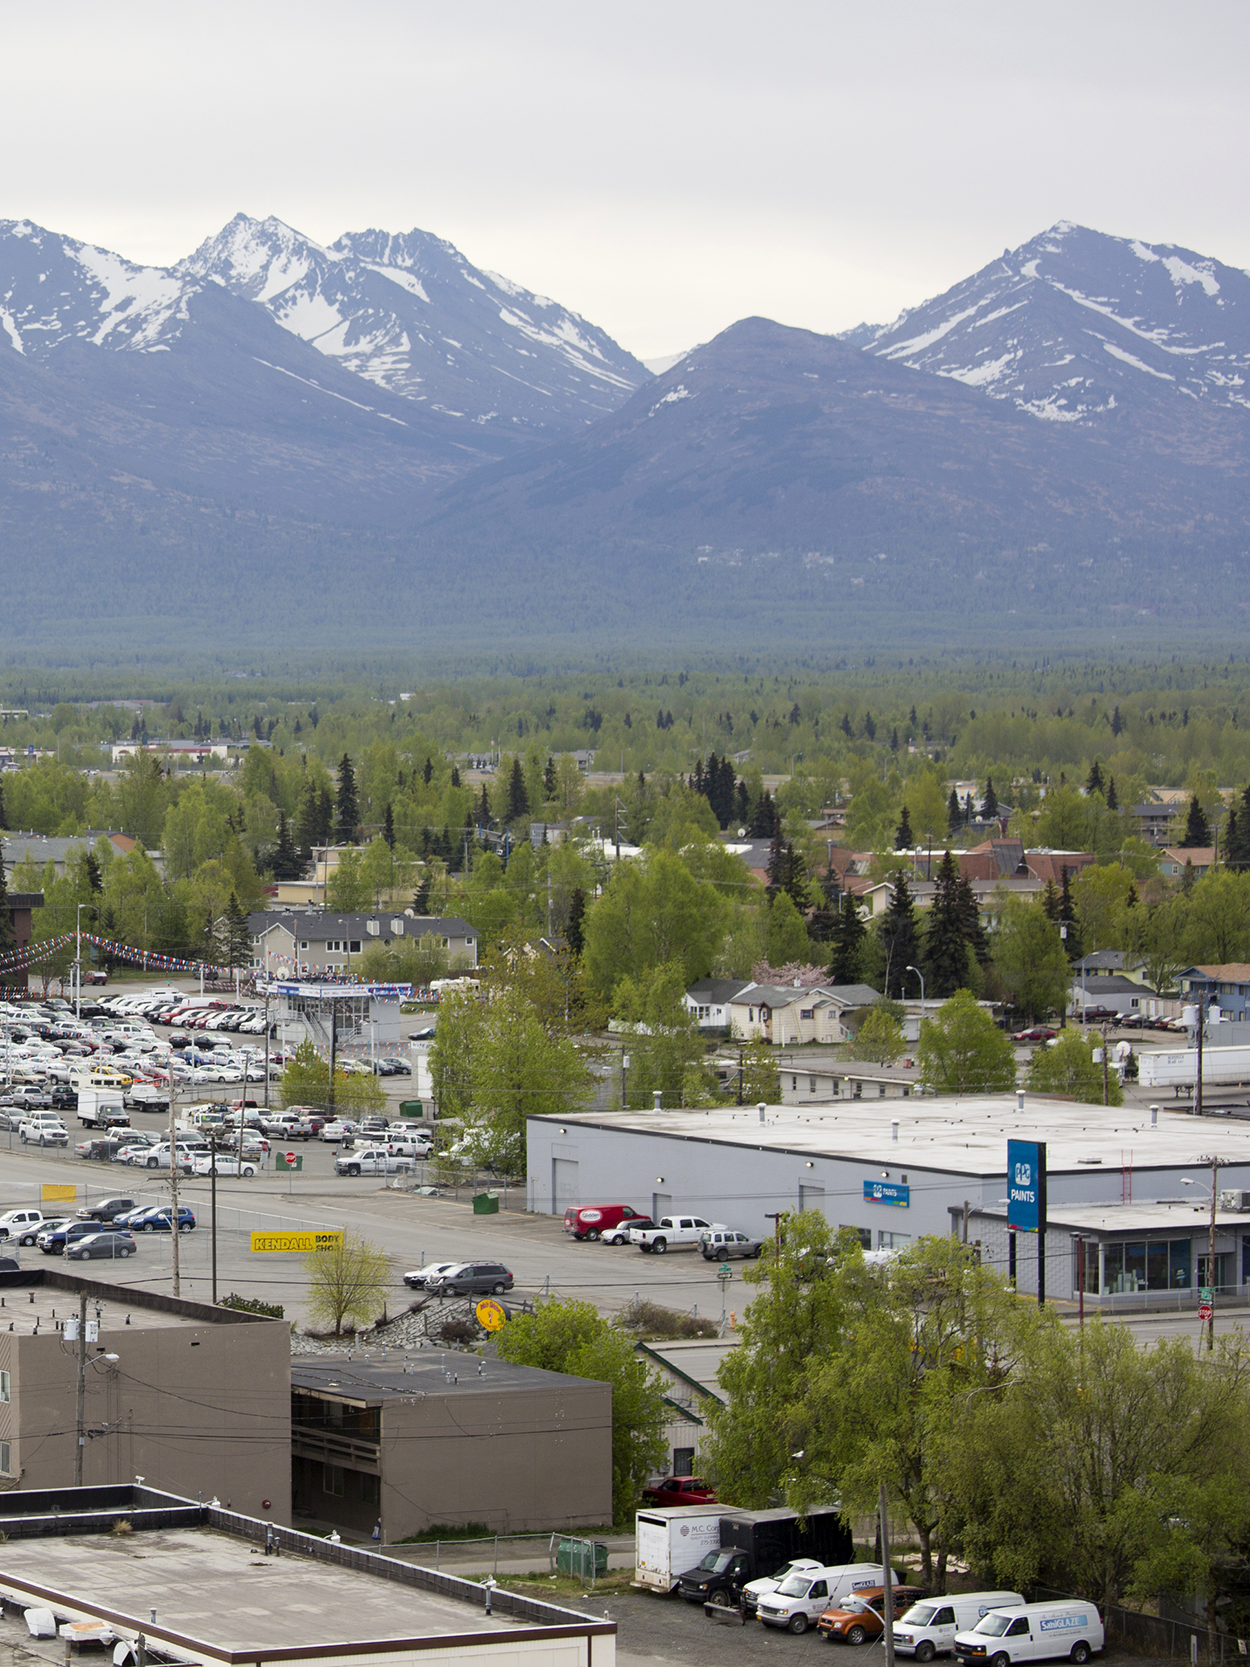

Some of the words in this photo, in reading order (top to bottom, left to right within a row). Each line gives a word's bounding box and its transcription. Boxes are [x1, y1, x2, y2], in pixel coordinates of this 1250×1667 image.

[882, 1188, 898, 1197] PAINTS
[1011, 1189, 1035, 1203] PAINTS
[255, 1238, 313, 1250] KENDALL
[315, 1235, 339, 1243] BODY
[1041, 1617, 1079, 1630] SaniGLAZE
